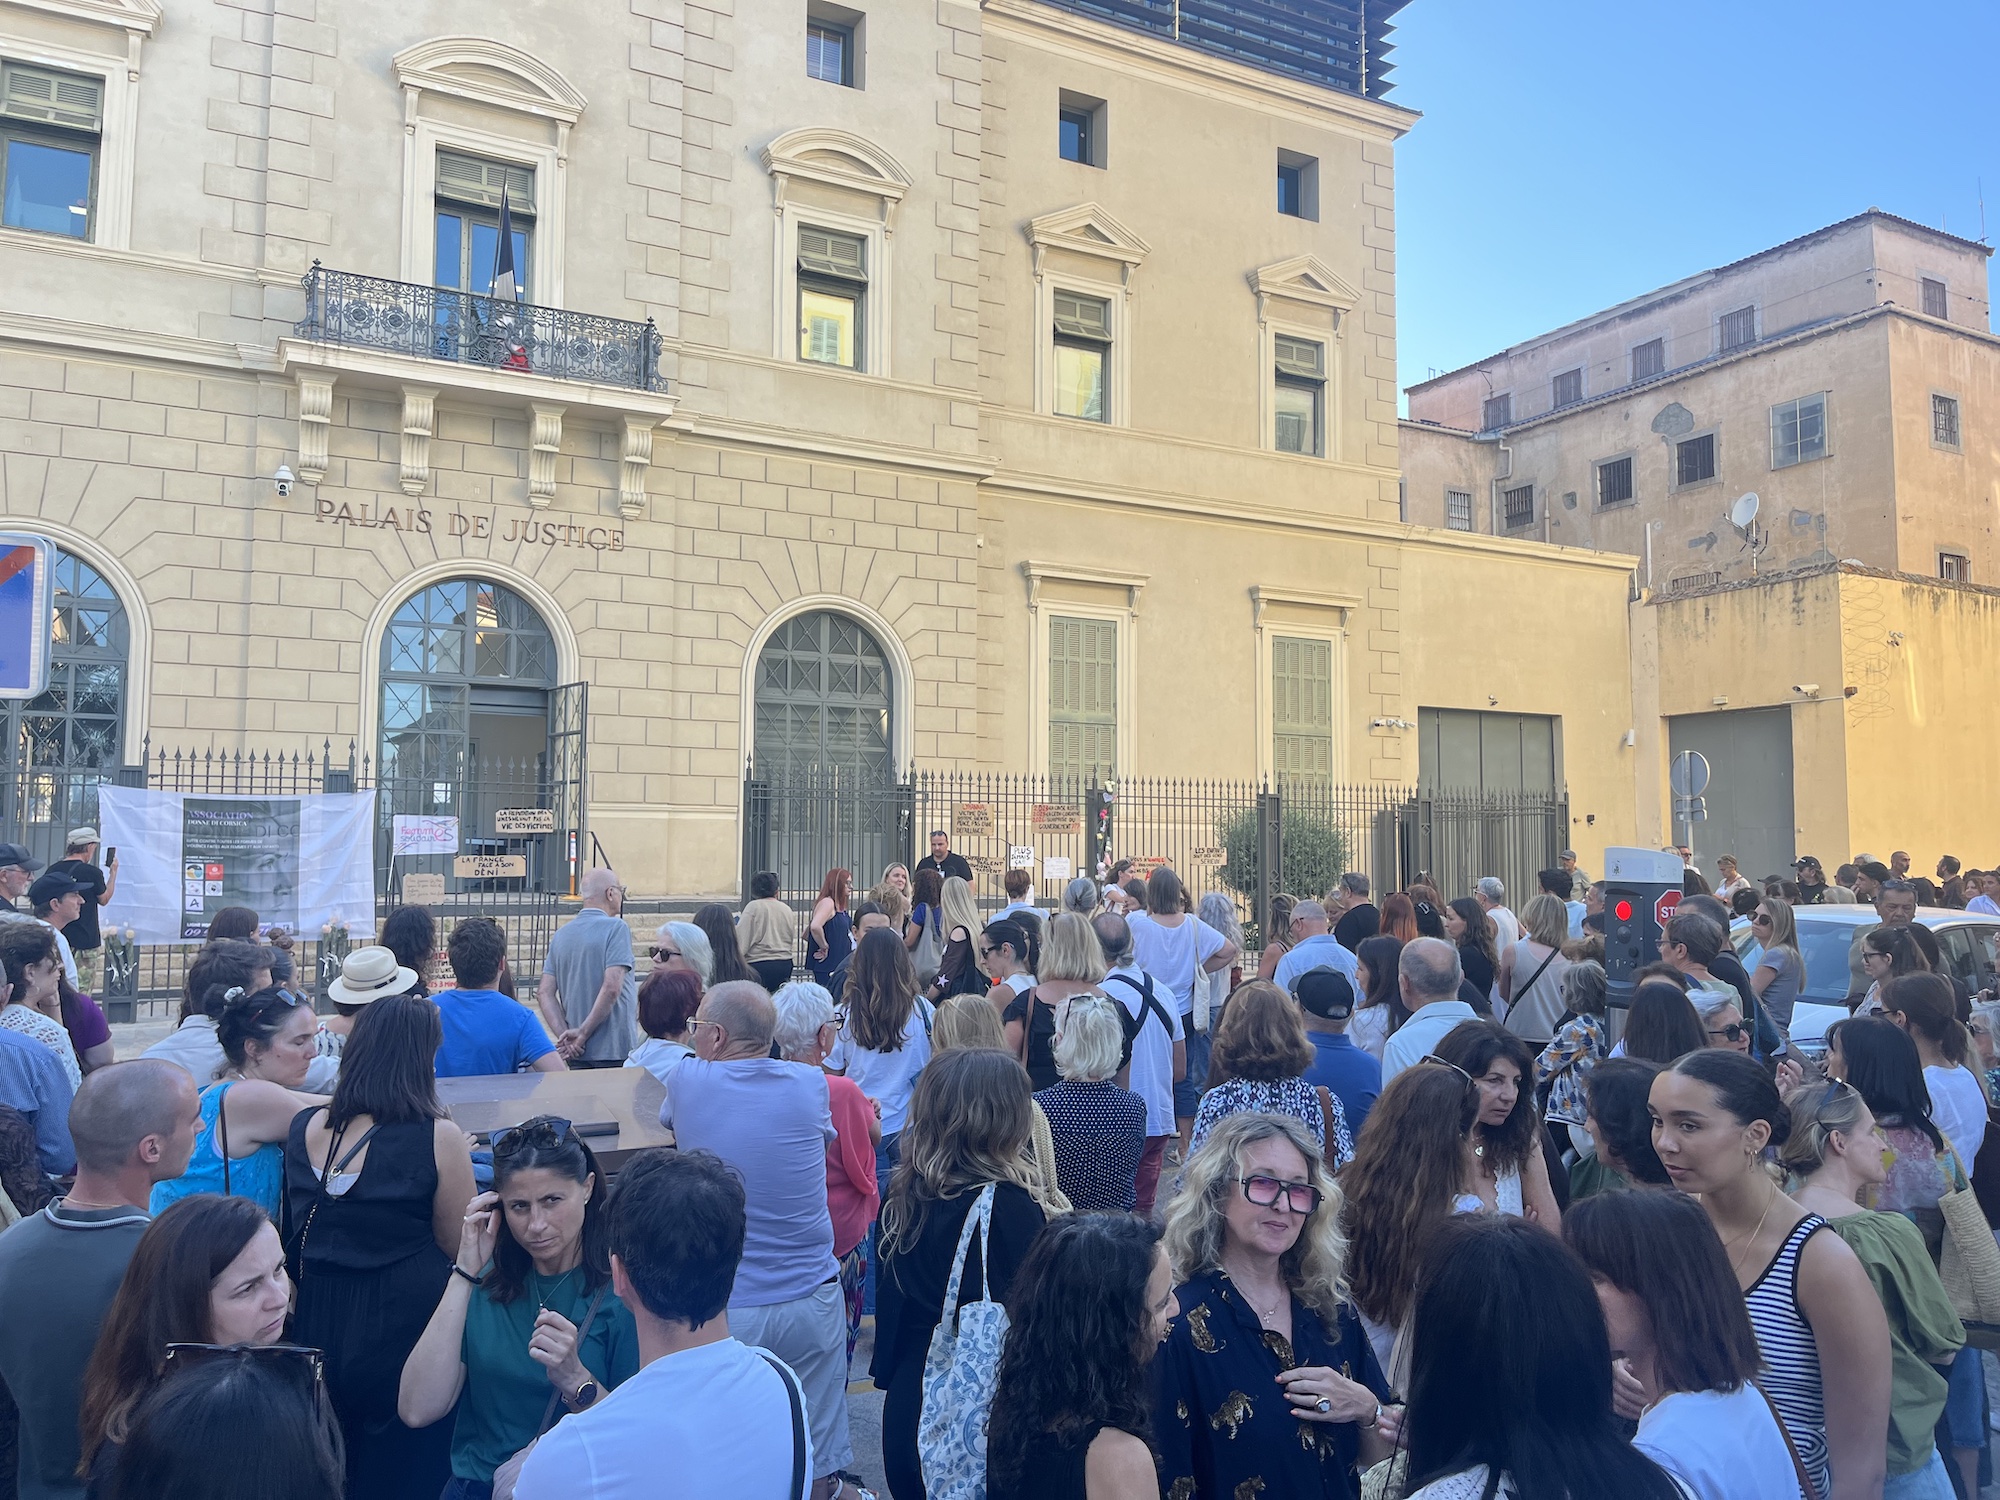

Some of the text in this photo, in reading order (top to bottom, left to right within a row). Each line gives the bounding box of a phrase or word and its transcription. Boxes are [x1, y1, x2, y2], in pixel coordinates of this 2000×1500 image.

[315, 499, 624, 552] PALAIS DE JUSTICE
[188, 810, 254, 819] ASSOCIATION
[256, 825, 271, 838] DI
[1661, 906, 1677, 919] ST
